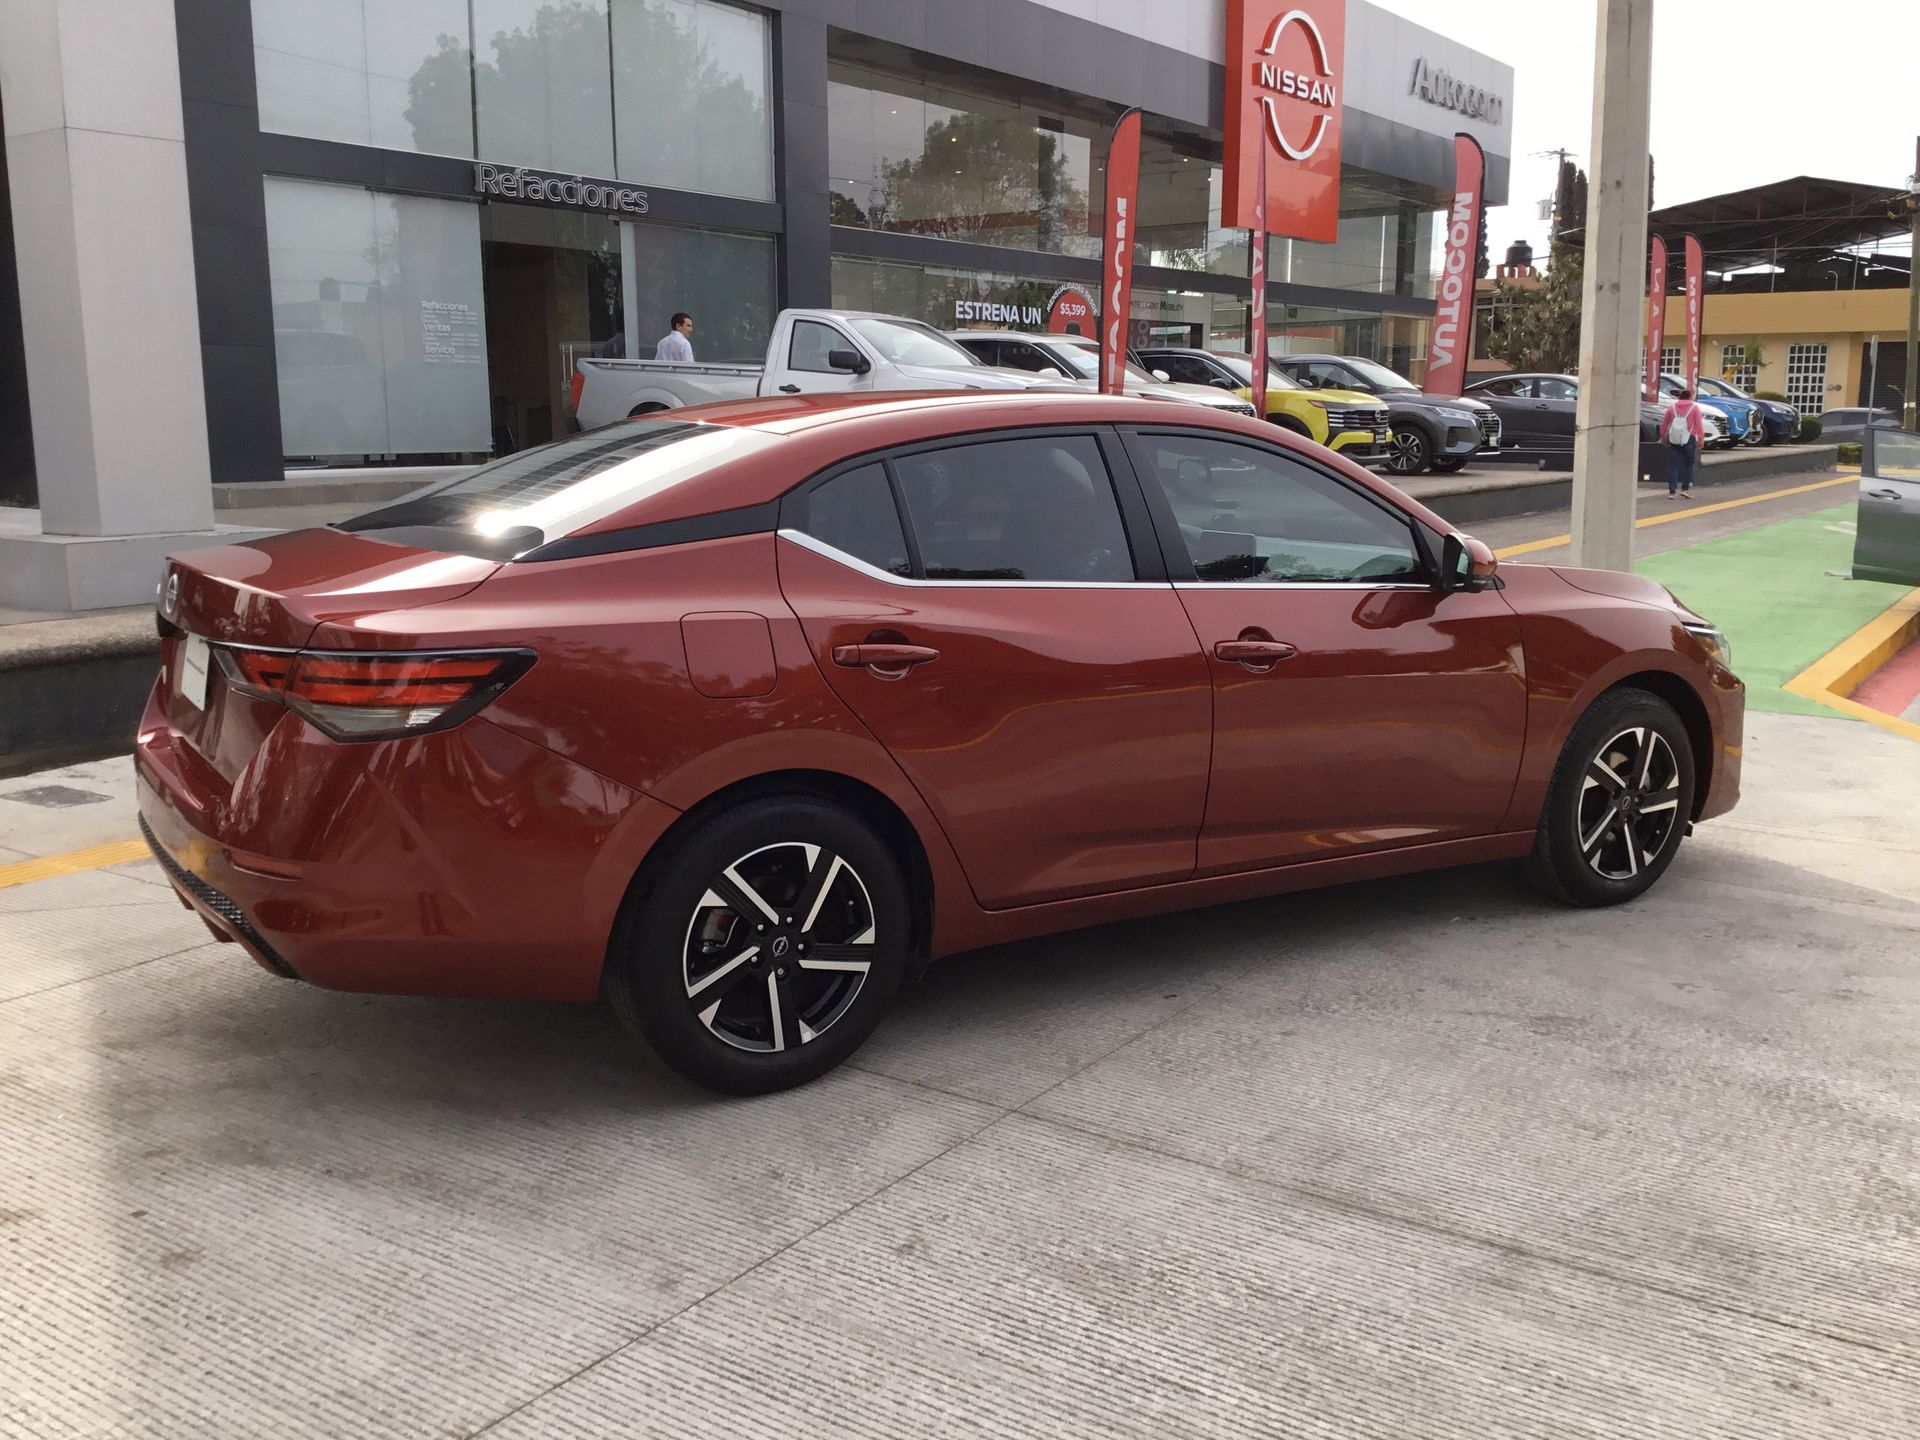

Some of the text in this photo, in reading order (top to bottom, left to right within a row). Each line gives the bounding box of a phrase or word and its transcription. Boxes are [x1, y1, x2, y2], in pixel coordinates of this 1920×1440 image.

[1261, 62, 1336, 107] NISSAN
[476, 163, 649, 214] Refacciones
[421, 300, 468, 311] Refacciones
[955, 300, 1042, 325] ESTRENA UN
[1060, 302, 1086, 316] $5,399
[423, 323, 451, 332] Ventas
[424, 345, 456, 354] Servicio
